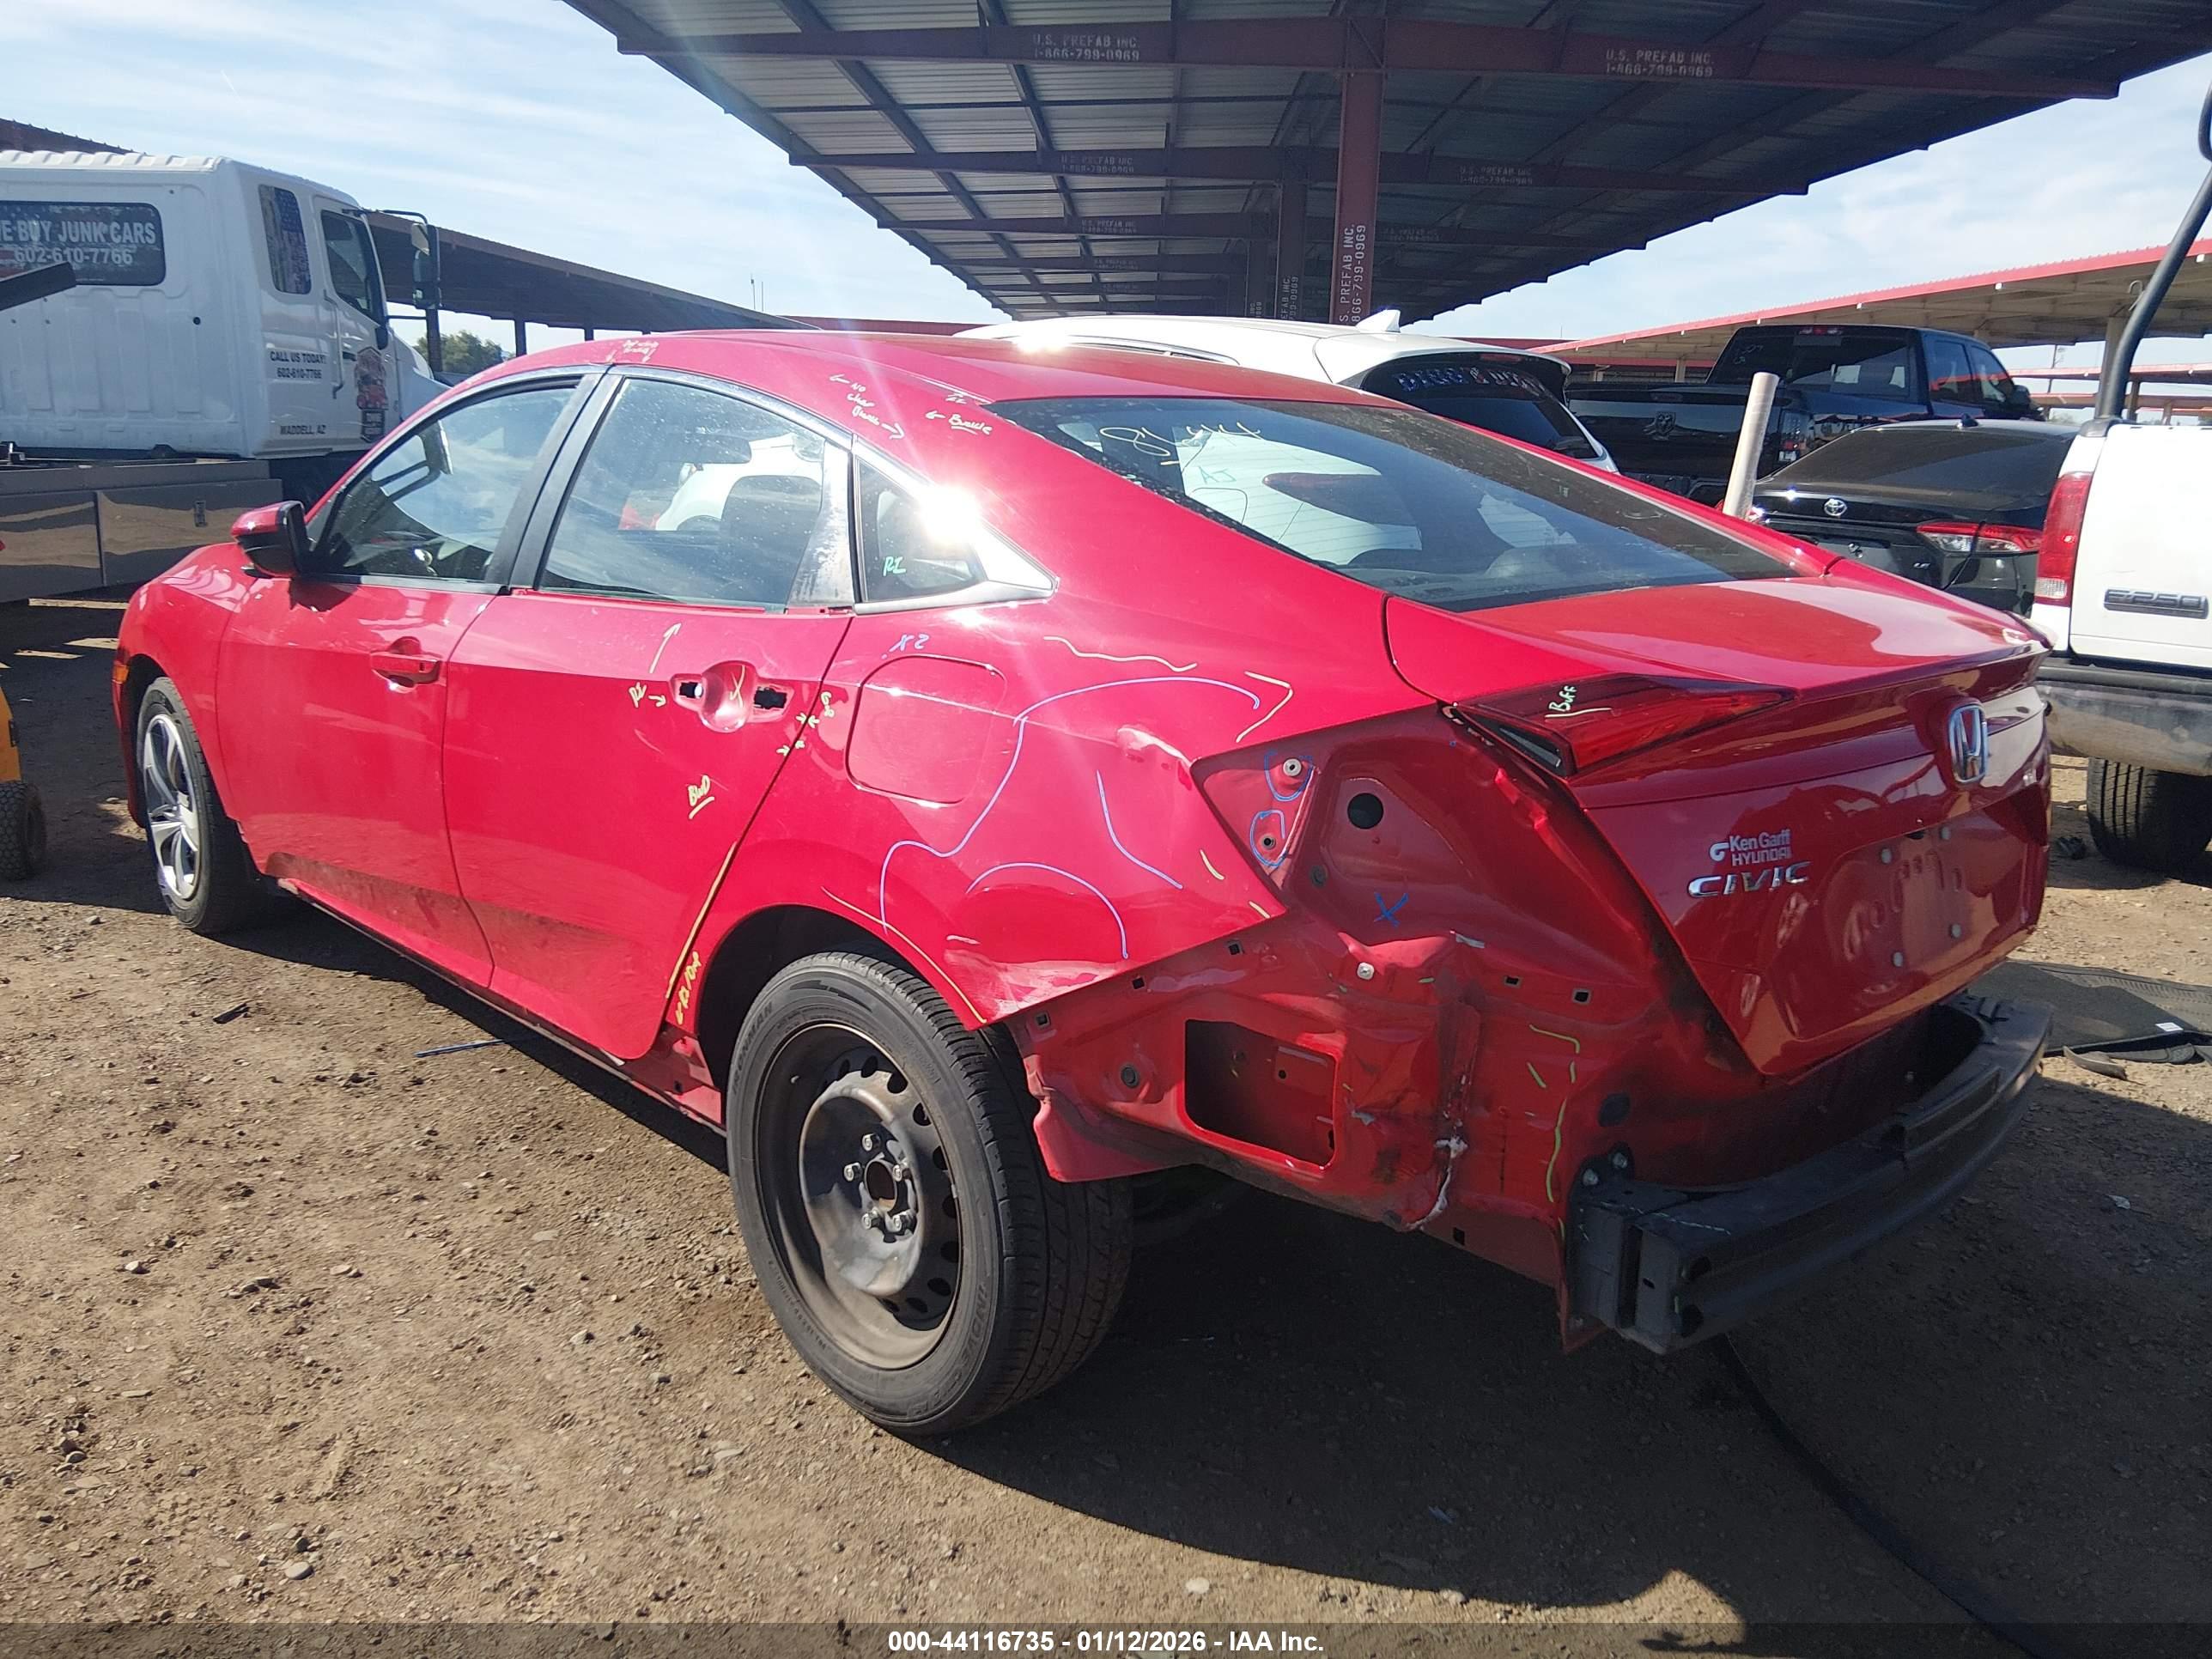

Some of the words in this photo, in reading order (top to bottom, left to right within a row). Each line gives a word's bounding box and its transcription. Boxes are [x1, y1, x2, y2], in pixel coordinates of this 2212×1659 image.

[1033, 33, 1057, 46] U.S.
[1063, 33, 1111, 47] PREFAB
[1606, 49, 1630, 63] U.S.
[1636, 49, 1685, 64] PREFAB
[0, 220, 13, 241] E
[16, 219, 52, 242] BUY
[58, 220, 105, 244] JUNK
[109, 222, 156, 245] CARS
[1342, 223, 1355, 249] INC.
[13, 246, 134, 265] 602-610-7766
[1340, 253, 1353, 304] PREFAB
[1351, 224, 1367, 322] 866-799-0969
[270, 350, 289, 362] CALL
[290, 353, 301, 363] US
[1729, 834, 1759, 853] Ken
[1731, 845, 1793, 866] HYUNDAI
[1688, 860, 1814, 897] CIVIC
